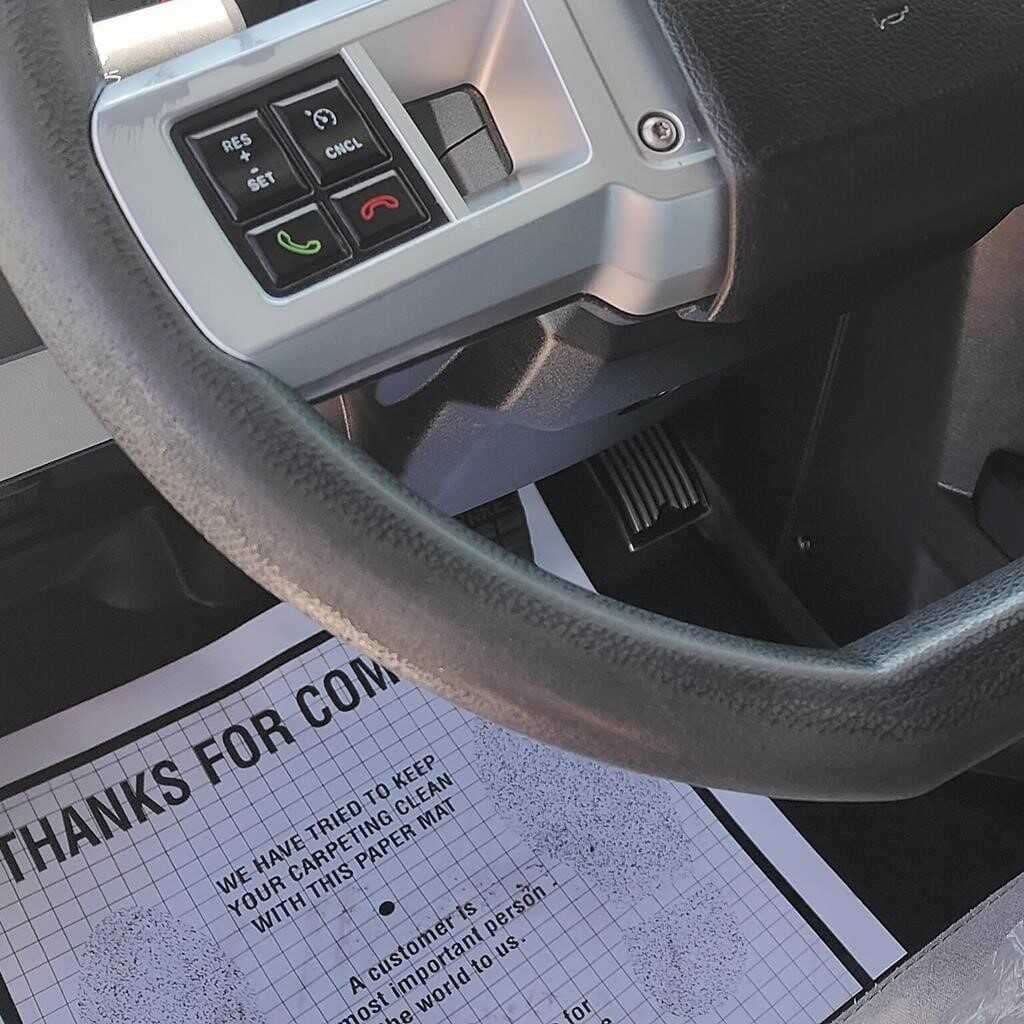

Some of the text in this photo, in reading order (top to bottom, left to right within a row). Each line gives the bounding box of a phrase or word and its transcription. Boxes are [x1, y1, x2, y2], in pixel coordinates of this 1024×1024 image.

[221, 132, 252, 153] RES
[247, 171, 277, 192] SET
[325, 137, 363, 160] CNCL
[0, 759, 191, 885] THANKS
[193, 708, 297, 786] FOR
[216, 754, 436, 894] WE HAVE TRIED TO KEEP
[227, 772, 454, 917] YOUR CARPETING CLEAN
[251, 797, 456, 934] WITH THIS PAPER MAT
[349, 901, 477, 995] A customer is
[390, 928, 484, 998] important
[484, 884, 546, 937] person
[415, 967, 471, 1013] world
[471, 954, 493, 976] to
[499, 934, 526, 958] us.
[563, 999, 591, 1024] for
